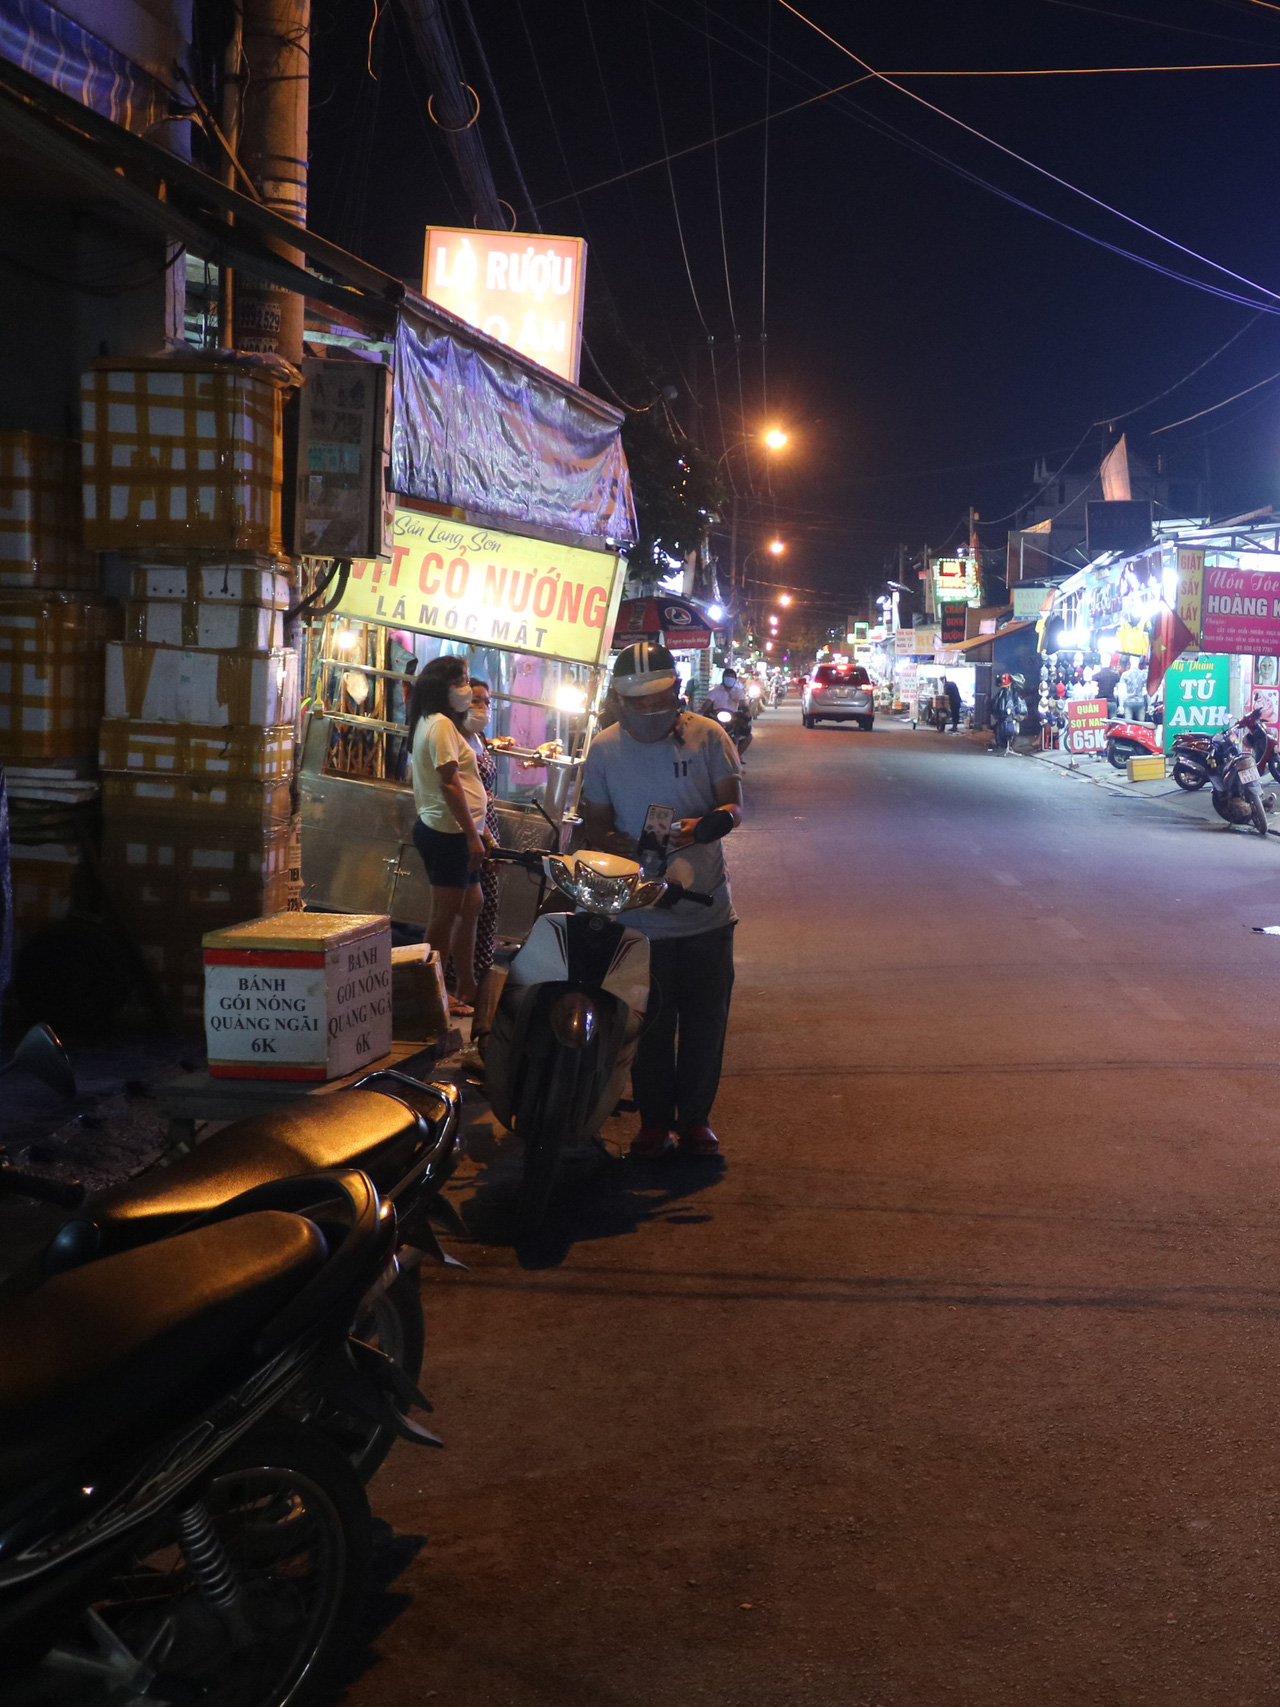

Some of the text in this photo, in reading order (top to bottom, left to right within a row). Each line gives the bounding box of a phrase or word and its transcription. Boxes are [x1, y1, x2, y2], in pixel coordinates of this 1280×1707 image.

[435, 238, 572, 301] LÒ RƯỢU
[467, 532, 502, 553] Sơn
[419, 546, 469, 600] CỎ
[485, 567, 608, 629] NƯỚNG
[1251, 573, 1280, 592] Tóc
[1207, 592, 1268, 617] HOÀNG
[376, 595, 547, 649] LÁ MÓC MẬT
[1180, 673, 1216, 700] TÚ
[1169, 705, 1227, 727] ANH
[1072, 729, 1105, 750] 65K
[348, 947, 377, 972] BÁNH
[239, 975, 286, 991] BÁNH
[337, 970, 389, 1005] GÓI NÓNG
[220, 994, 306, 1012] GÓI NÓNG
[210, 1013, 318, 1031] QUẢNG NGÃI
[251, 1038, 277, 1053] 6K
[356, 1032, 371, 1055] 6K
